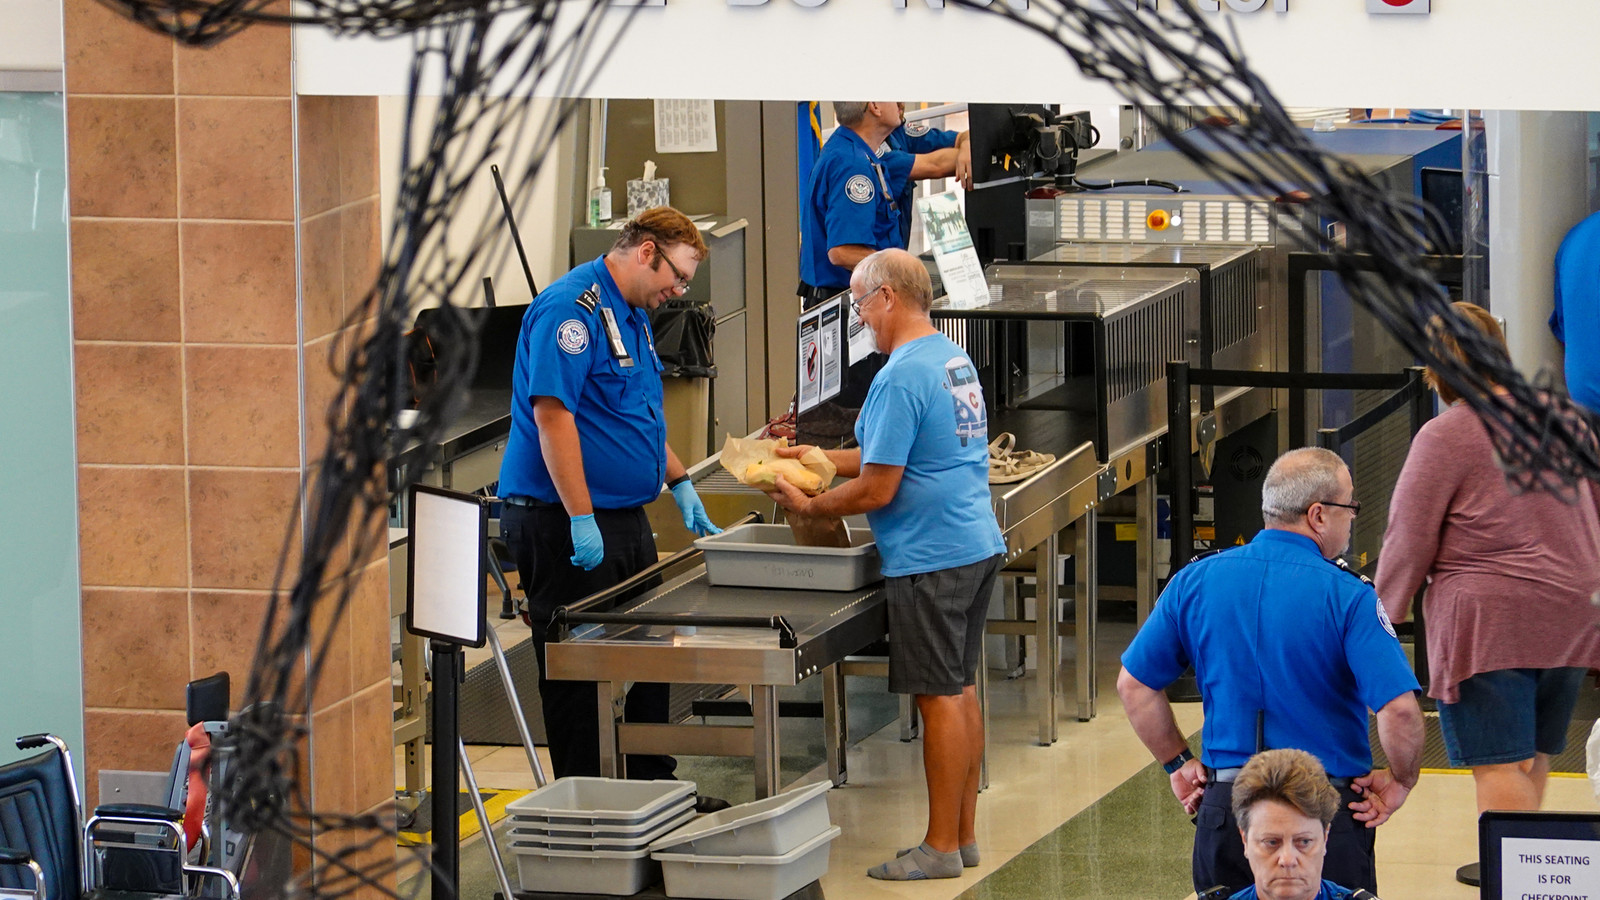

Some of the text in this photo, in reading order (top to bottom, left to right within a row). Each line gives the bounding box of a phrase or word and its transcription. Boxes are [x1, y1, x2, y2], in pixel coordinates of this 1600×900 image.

[584, 294, 596, 306] TSA
[1518, 854, 1590, 866] THIS SEATING
[1538, 874, 1571, 884] IS FOR
